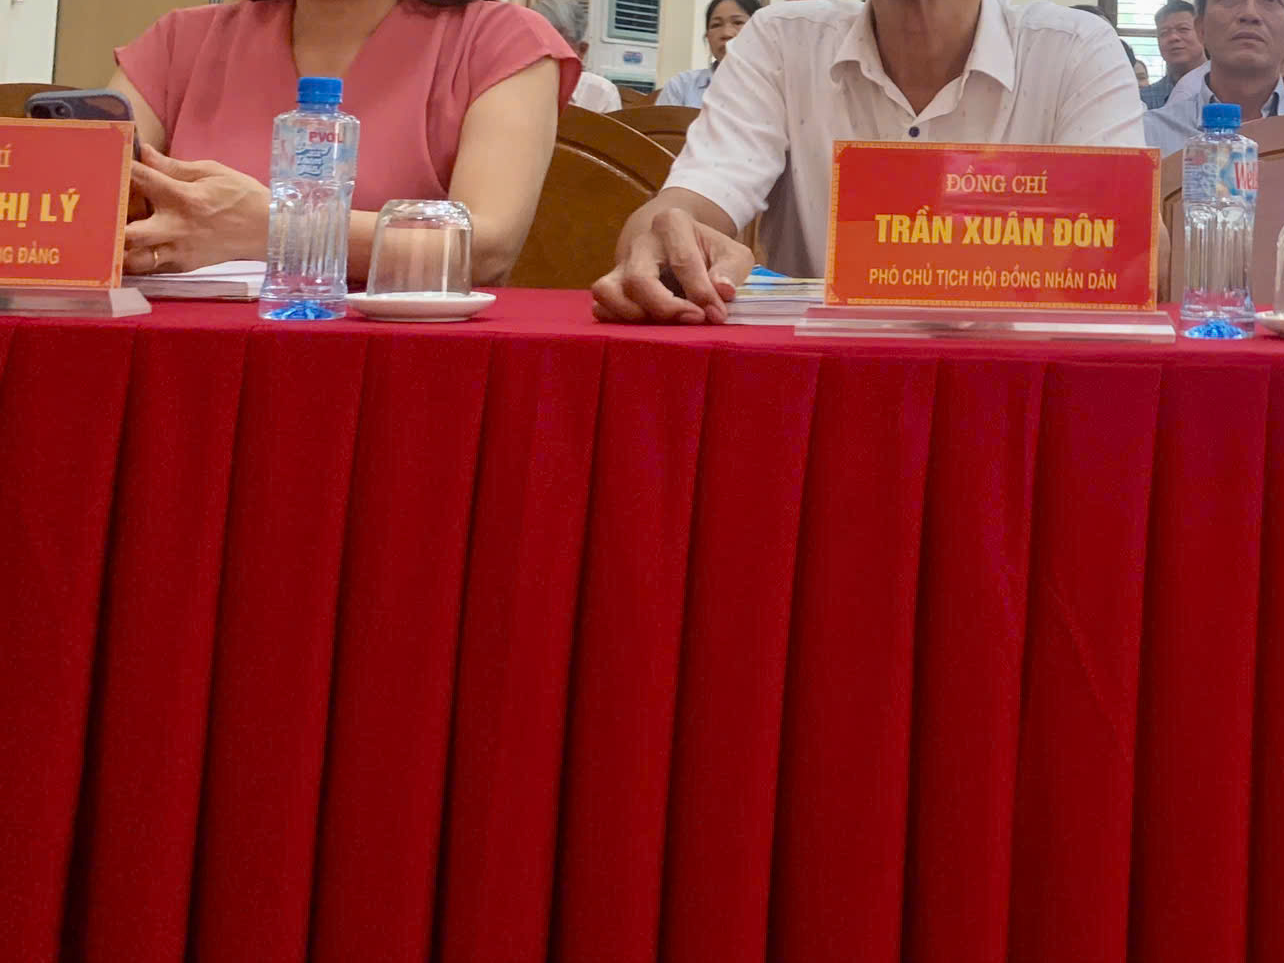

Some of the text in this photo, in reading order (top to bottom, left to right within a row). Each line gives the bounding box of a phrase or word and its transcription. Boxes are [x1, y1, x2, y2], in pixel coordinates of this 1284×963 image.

[946, 165, 1048, 195] ĐỒNG CHÍ
[40, 188, 81, 223] LÝ
[875, 205, 1115, 248] TRẦN XUÂN ĐÔN
[17, 240, 60, 265] ĐẢNG
[869, 262, 1117, 291] PHÓ CHỦ TỊCH HỘI ĐỒNG NHÂN DÂN
